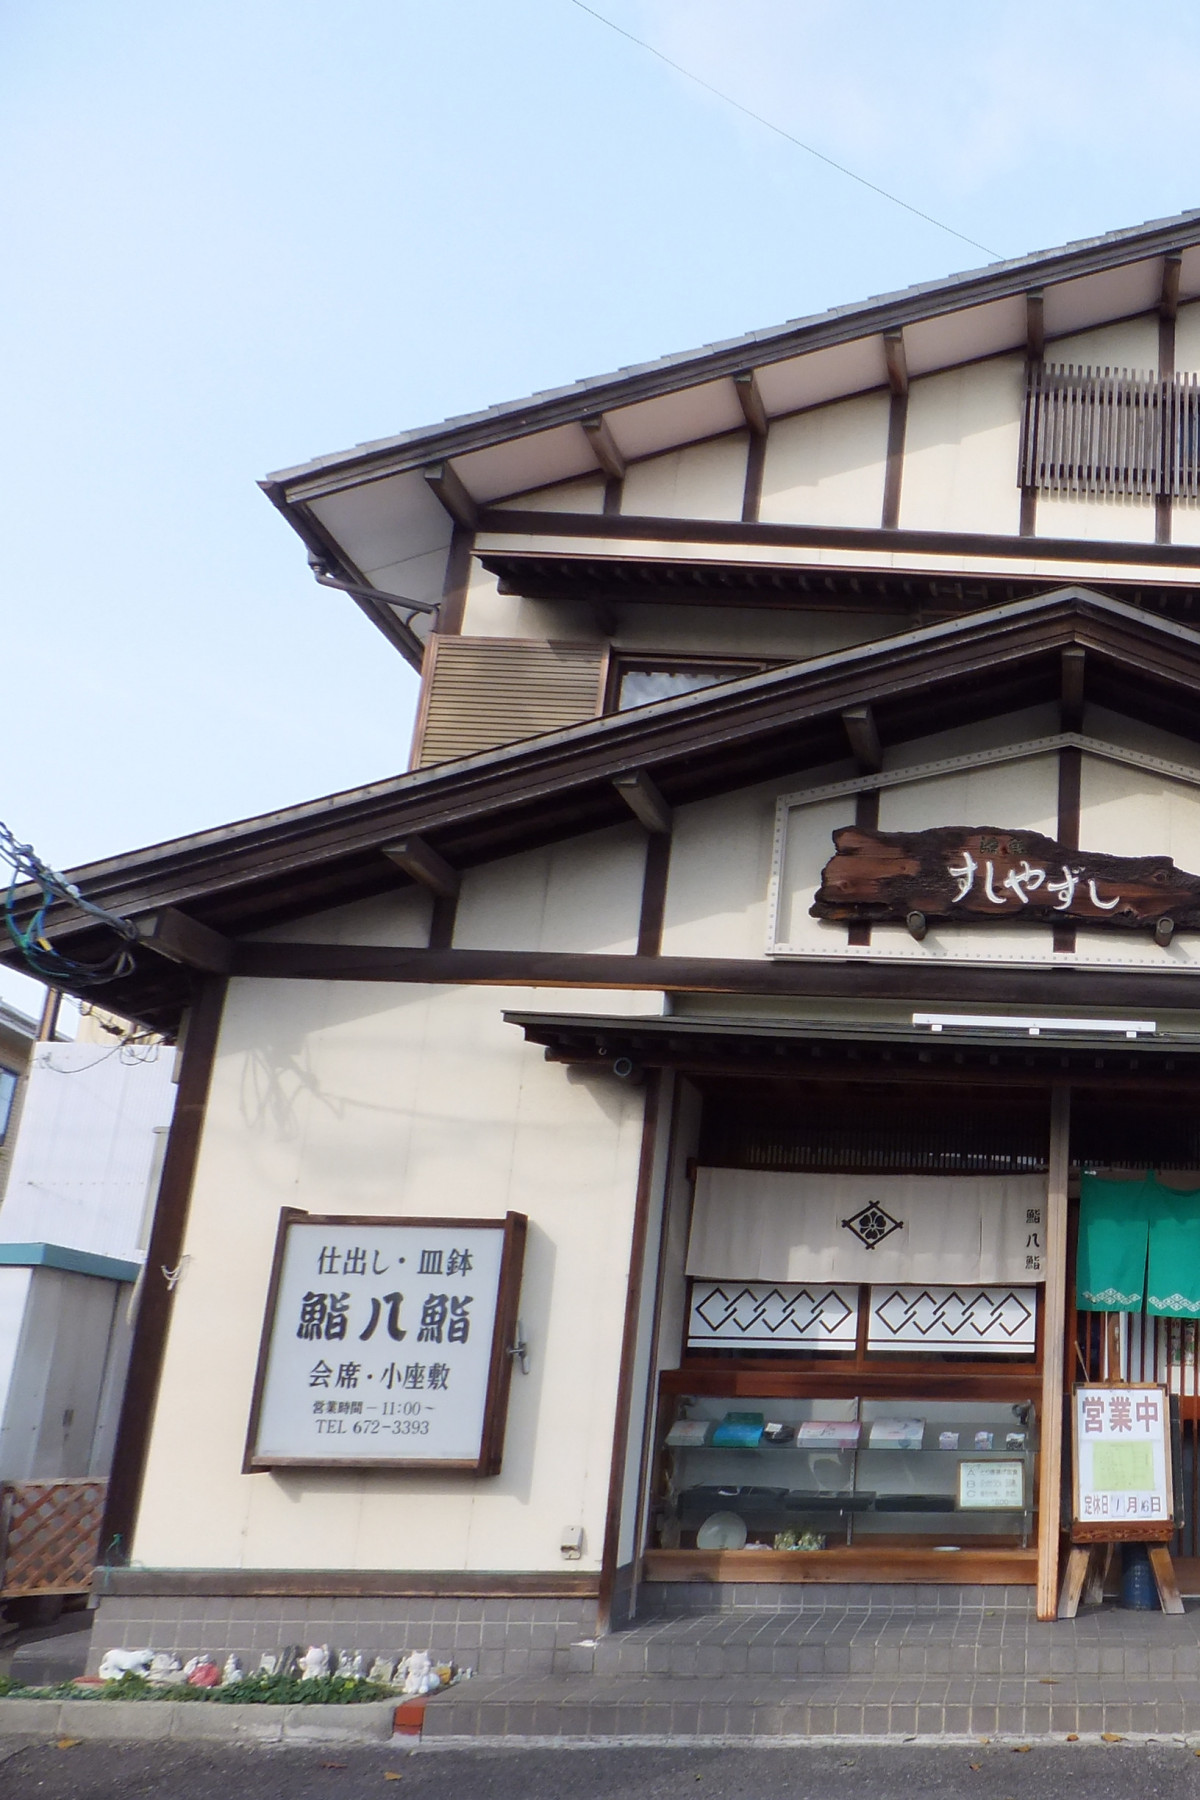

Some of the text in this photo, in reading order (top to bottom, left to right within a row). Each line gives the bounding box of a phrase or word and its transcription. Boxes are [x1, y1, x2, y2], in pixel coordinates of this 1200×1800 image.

[947, 851, 1120, 910] すしやずし
[1025, 1208, 1041, 1271] 鮨八鮨
[317, 1246, 474, 1278] 仕出し・皿鉢
[296, 1291, 474, 1345] 鮨八鮨
[308, 1359, 452, 1391] 会席・小座敷
[315, 1419, 430, 1436] TEL 672-3393
[1082, 1396, 1159, 1433] 営業中
